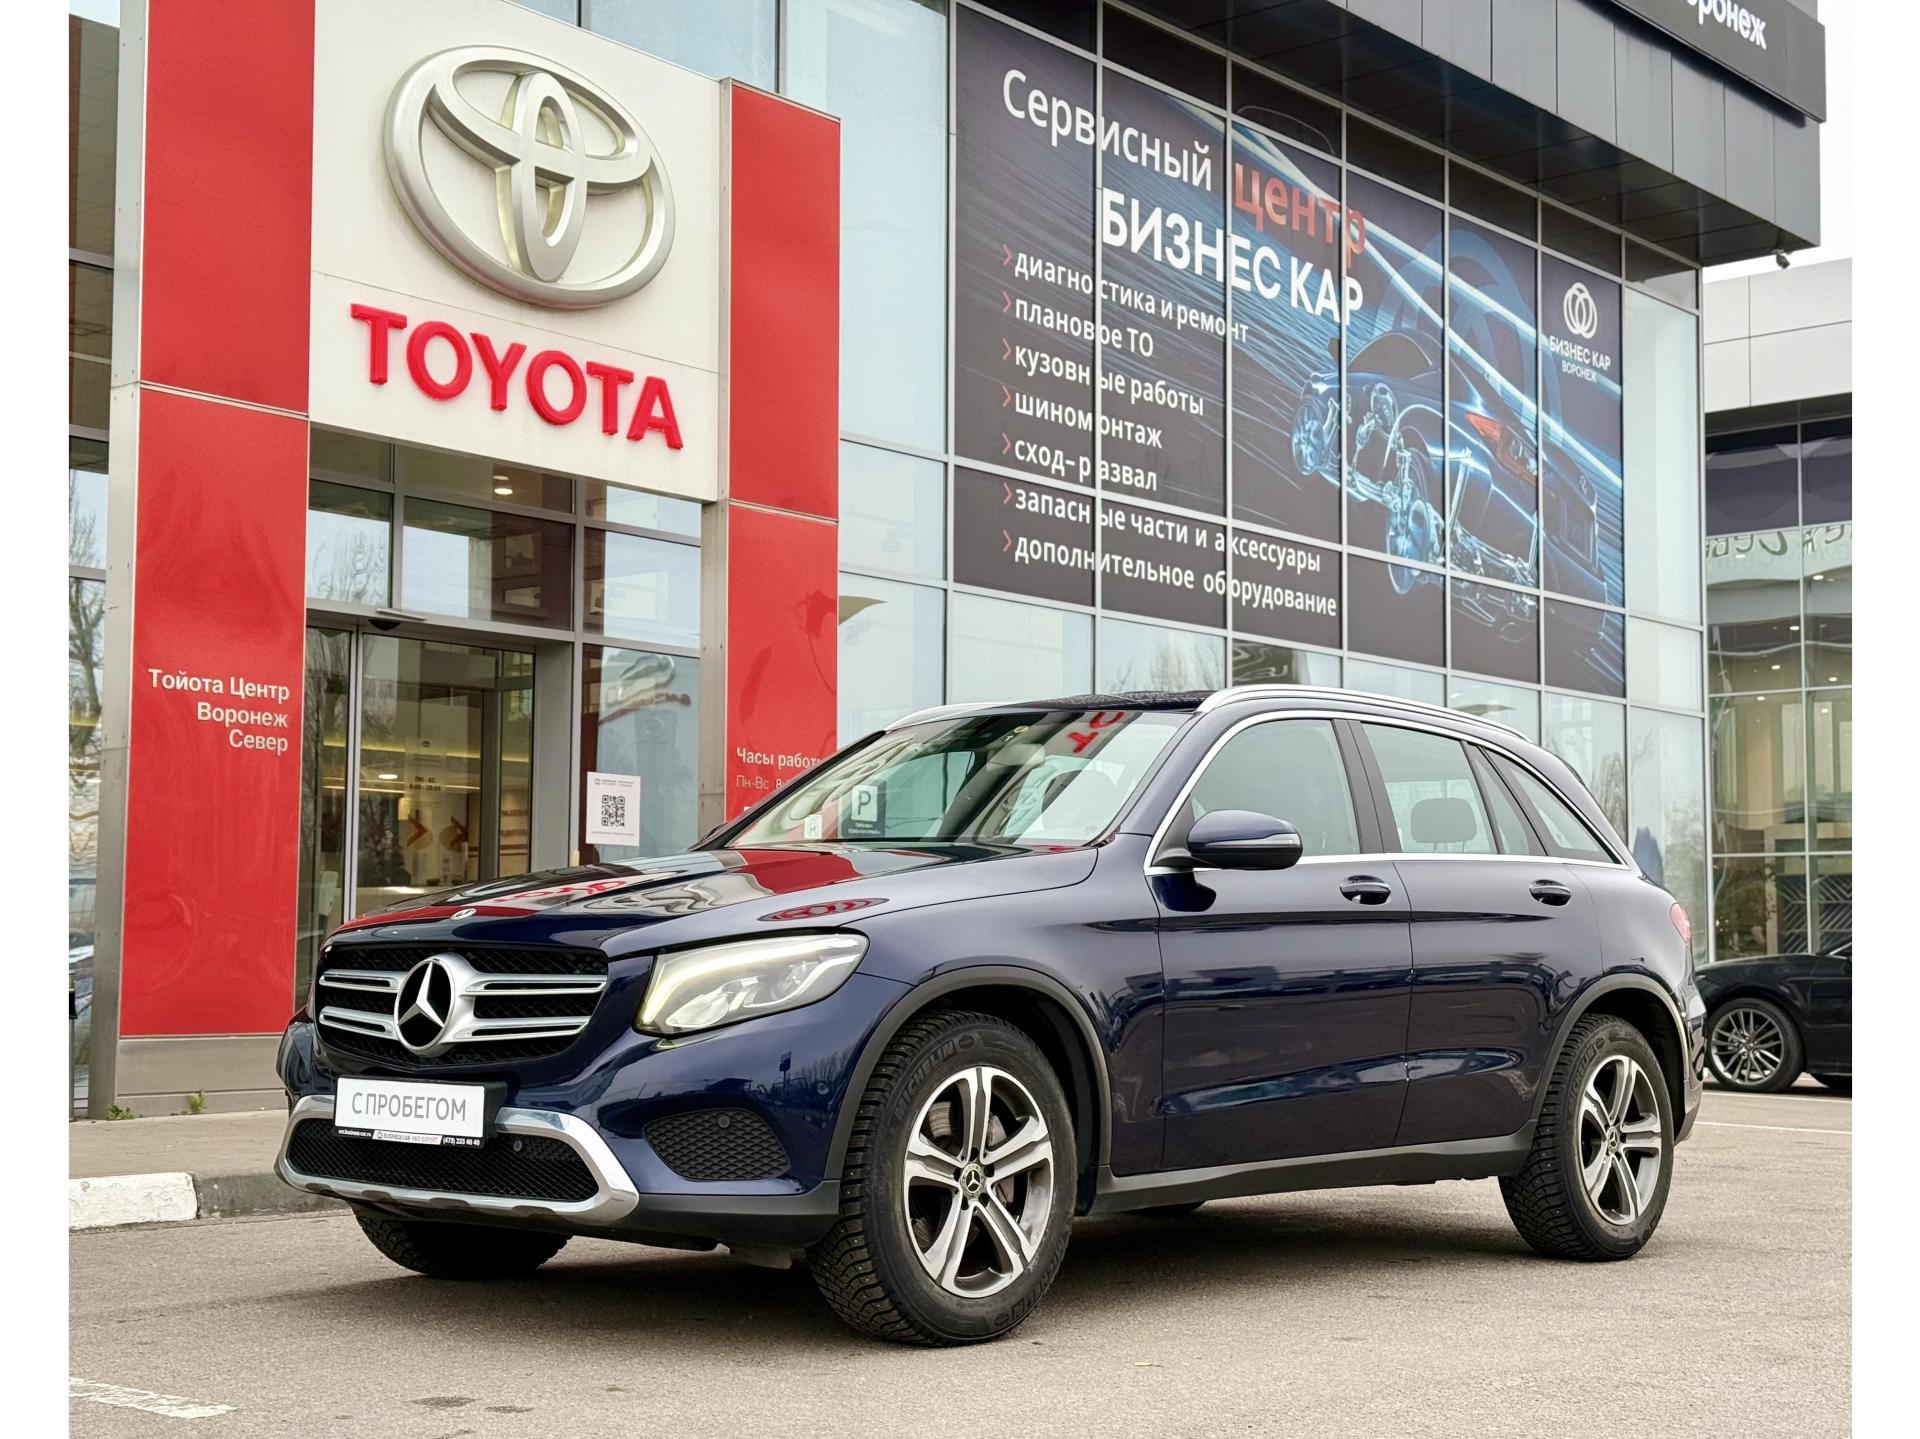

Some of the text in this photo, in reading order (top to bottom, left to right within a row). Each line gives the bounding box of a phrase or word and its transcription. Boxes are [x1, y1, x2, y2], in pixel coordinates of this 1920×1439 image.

[1686, 0, 1767, 50] ронеж
[1003, 69, 1366, 269] Сервисный центр
[1101, 187, 1364, 325] БИЗНЕС КАР
[1015, 251, 1249, 343] диагностика и ремонт
[1015, 297, 1154, 357] плановое ТО
[1549, 335, 1611, 371] БИЗНЕС КАР
[350, 303, 684, 450] TOYOTA
[1015, 345, 1204, 416] кузовные работы
[1562, 360, 1598, 384] ВОРОНЕЖ
[1015, 392, 1163, 449] шиномонтаж
[1014, 437, 1157, 491] сход-развал
[1015, 489, 1320, 575] запасные части и аксессуары
[1014, 534, 1337, 616] дополнительное оборудование
[148, 668, 290, 703] Тойота Центр
[197, 703, 288, 728] Воронеж
[228, 729, 288, 755] Север
[736, 747, 820, 770] Часы работ
[736, 775, 769, 789] Пн-Вс
